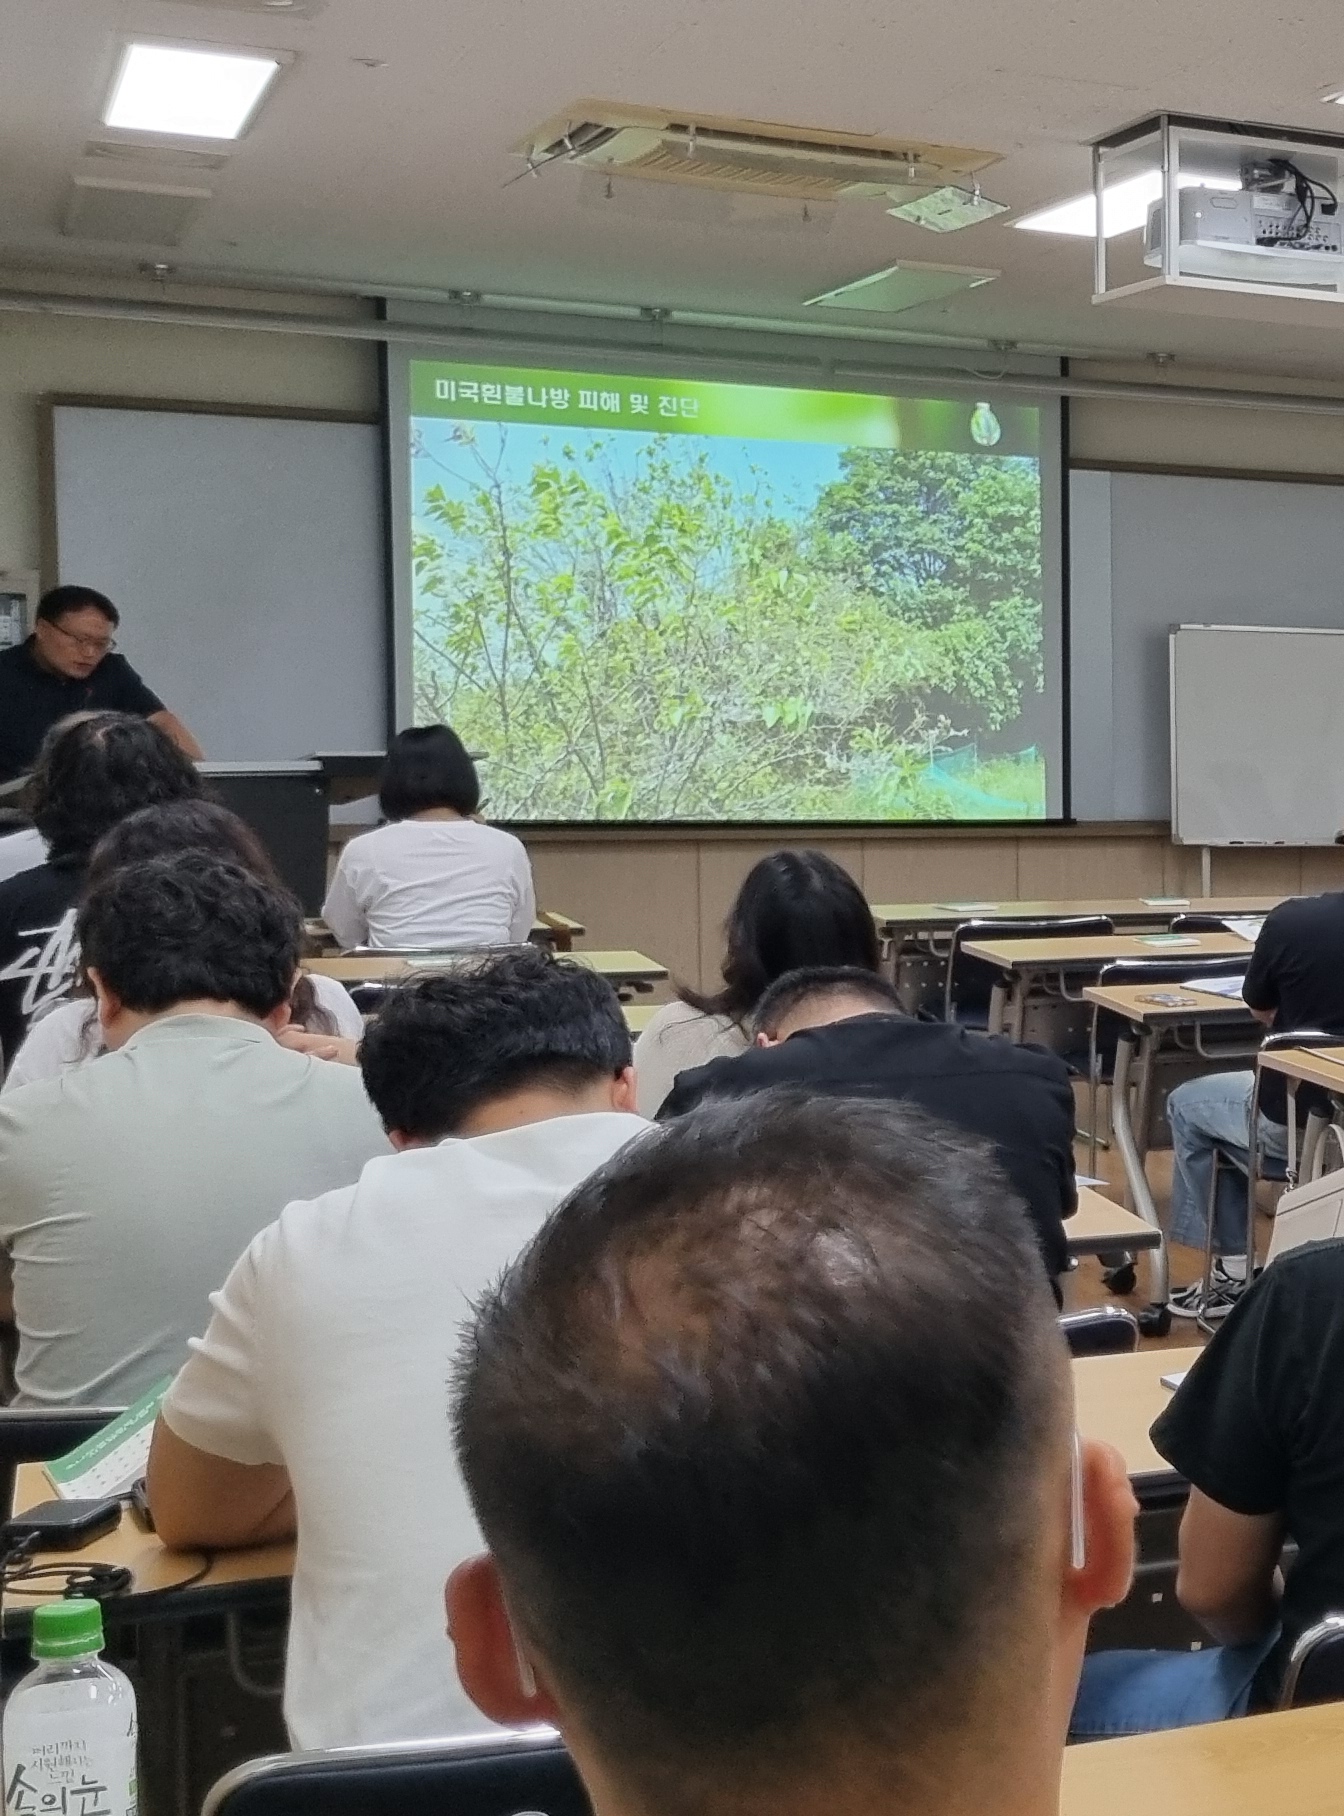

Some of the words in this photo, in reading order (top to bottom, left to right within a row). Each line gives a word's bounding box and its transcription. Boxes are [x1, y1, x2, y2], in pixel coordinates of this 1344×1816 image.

[434, 379, 570, 410] 미국흰불나방
[578, 389, 621, 413] 피해
[629, 393, 649, 415] 및
[657, 396, 700, 418] 진단
[32, 1739, 88, 1756] 머리까지
[6, 1763, 112, 1816] 솔의눈
